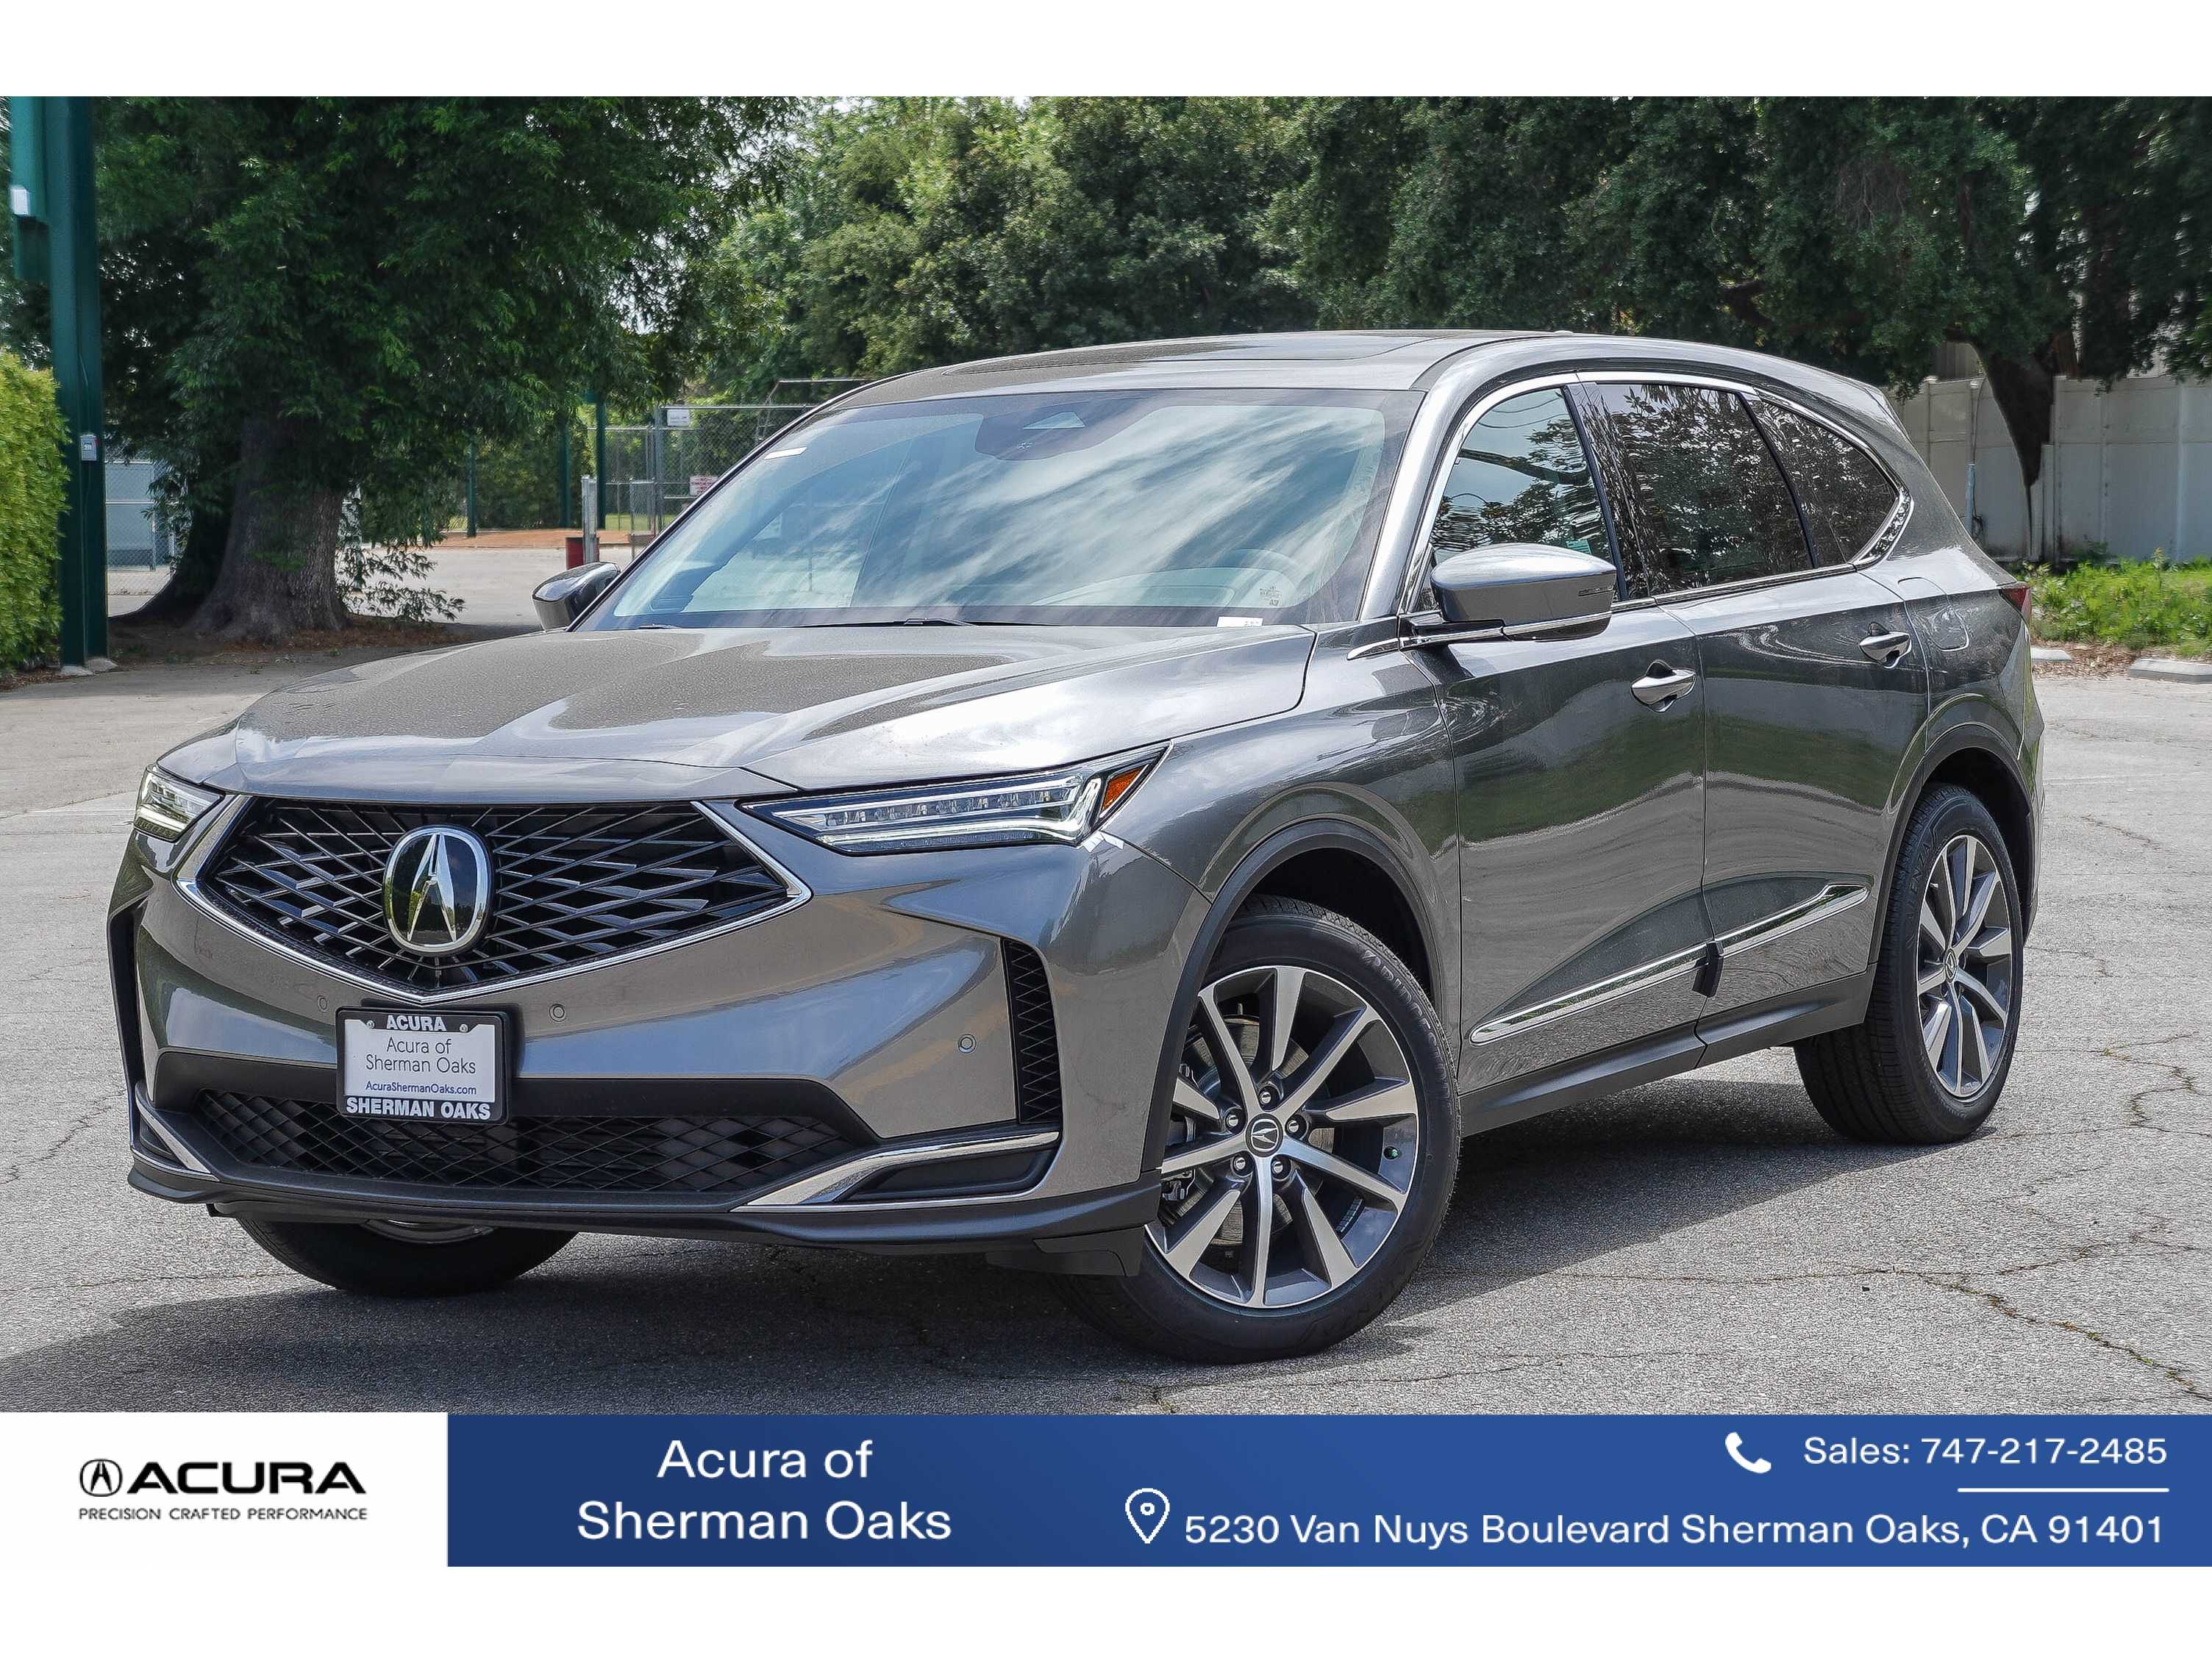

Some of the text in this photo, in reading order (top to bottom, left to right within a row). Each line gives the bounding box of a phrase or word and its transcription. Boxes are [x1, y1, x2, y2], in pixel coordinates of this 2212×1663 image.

[386, 1015, 447, 1032] ACURA
[386, 1036, 452, 1054] Acura of
[365, 1054, 477, 1075] Sherman Oaks
[365, 1080, 477, 1095] AcuraShermanOaks.com
[346, 1098, 491, 1120] SHERMAN OAKS
